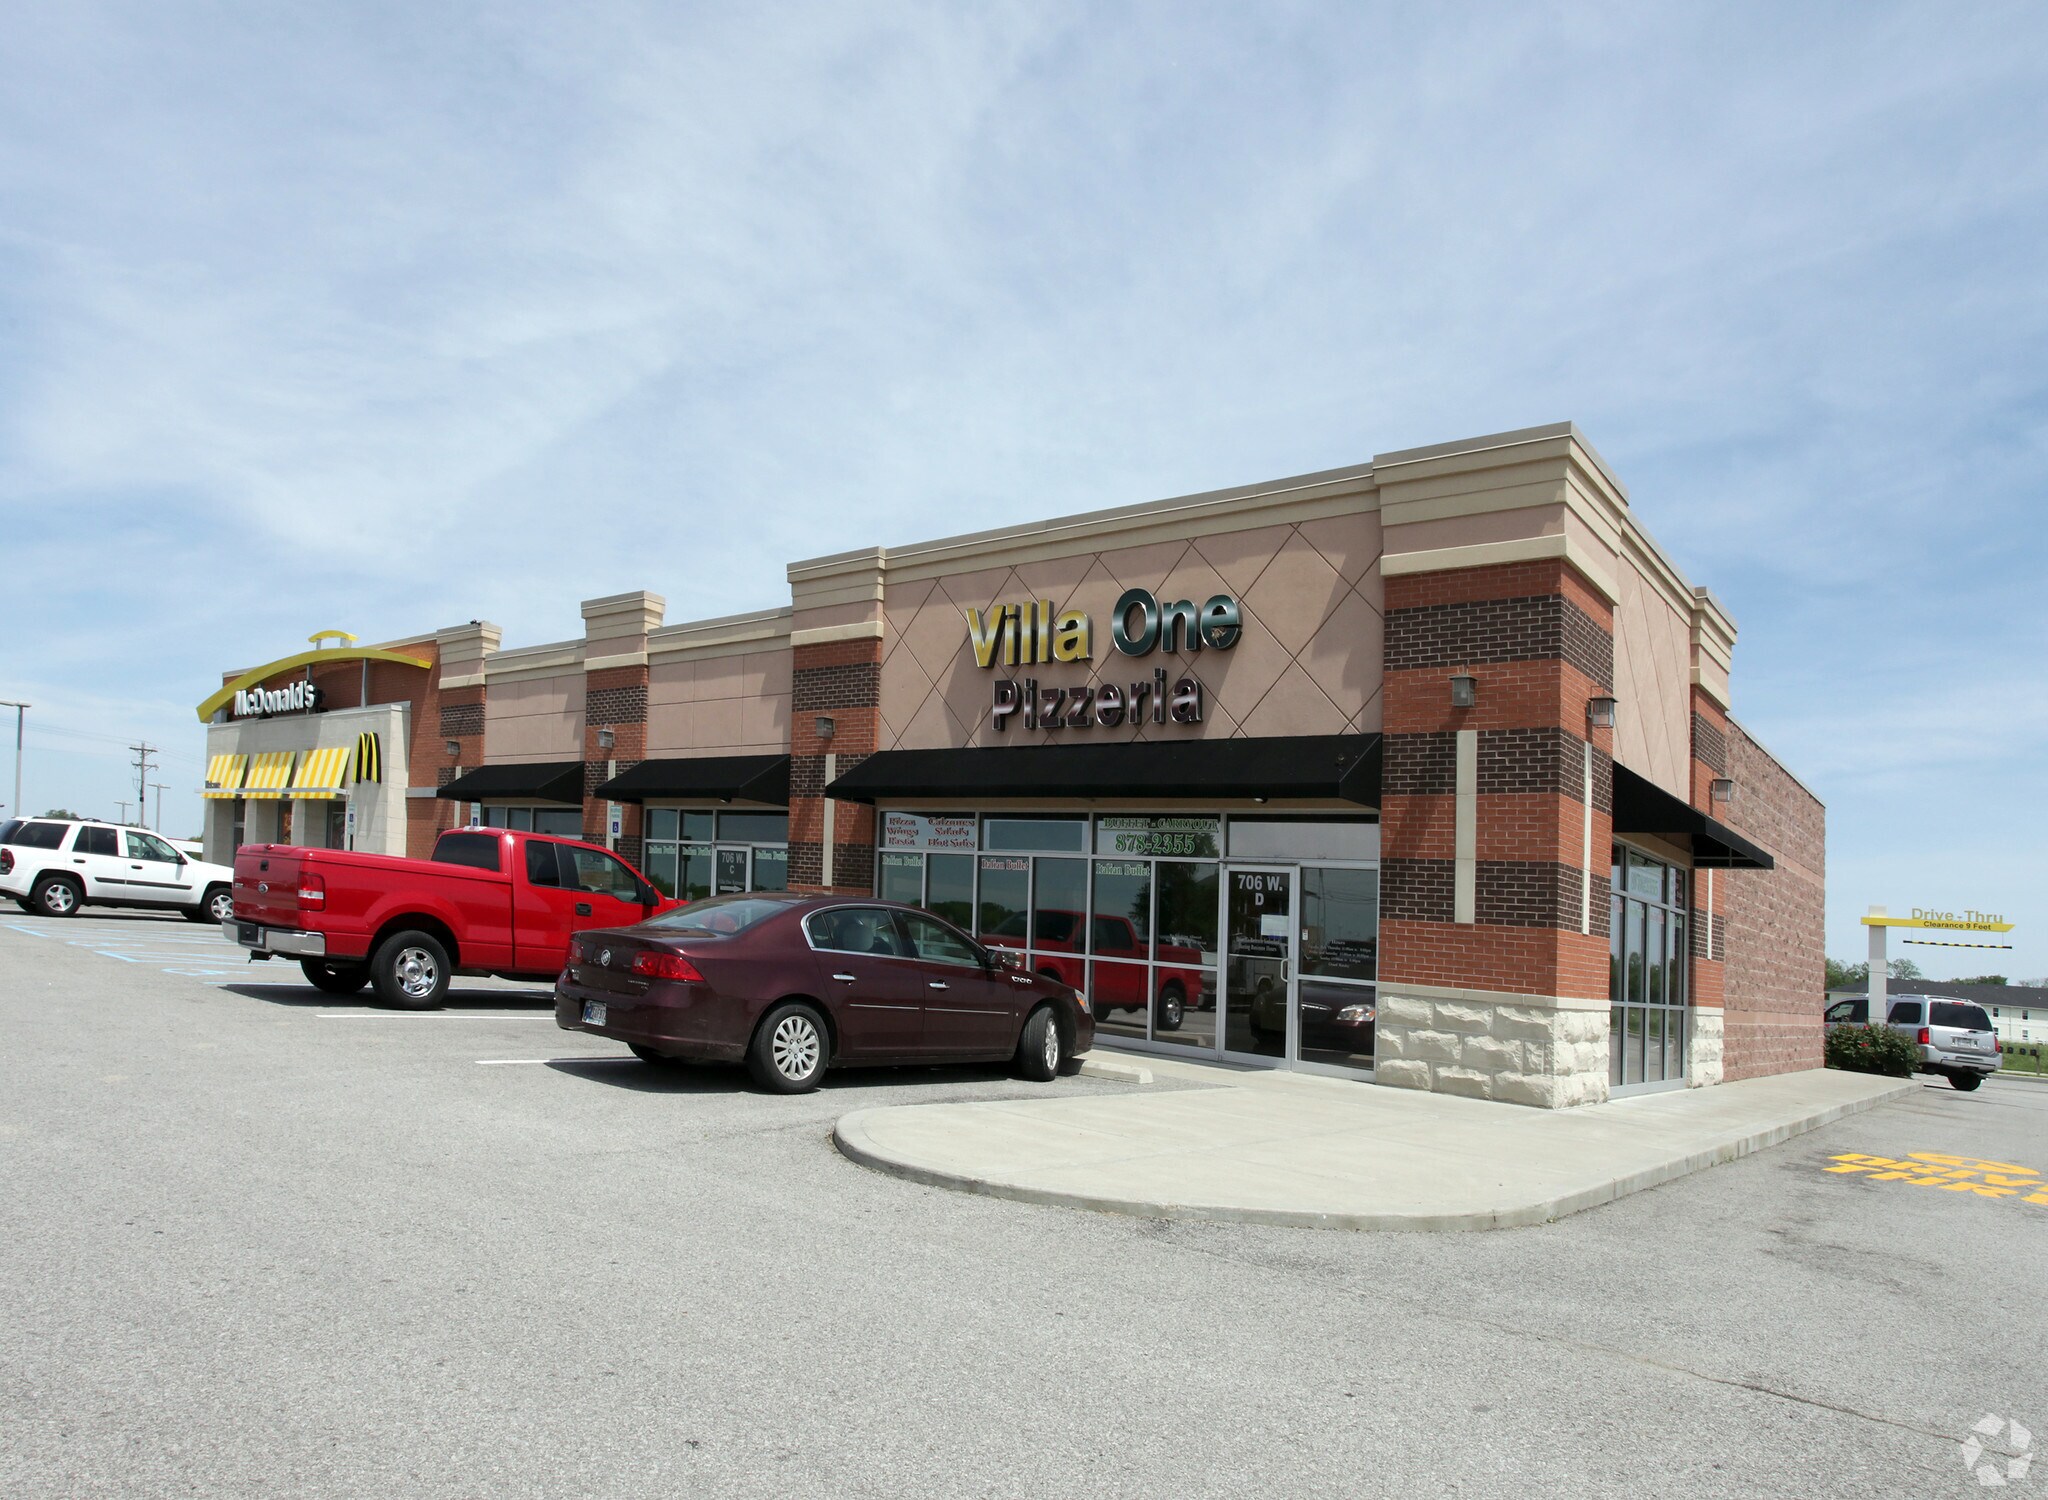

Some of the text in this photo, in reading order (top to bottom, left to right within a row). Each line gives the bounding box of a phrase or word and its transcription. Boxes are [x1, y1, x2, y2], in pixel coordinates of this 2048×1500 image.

[966, 587, 1243, 668] Villa One
[234, 680, 315, 716] McDonald's
[992, 668, 1203, 731] Pizzeria
[889, 817, 916, 827] Pizza
[1103, 818, 1150, 829] BUFFET
[1157, 818, 1219, 831] CARRYOUT
[886, 827, 919, 838] Wings
[935, 827, 970, 837] Salads
[1115, 833, 1195, 854] 878-2355
[721, 852, 734, 864] 706
[729, 865, 735, 874] C
[981, 858, 1029, 872] Italian Buffet
[1096, 862, 1150, 877] Italian Buffet
[1238, 874, 1283, 892] 706 W.
[1255, 893, 1264, 906] D
[1923, 920, 1964, 930] Clearance
[1973, 923, 1992, 931] Feet
